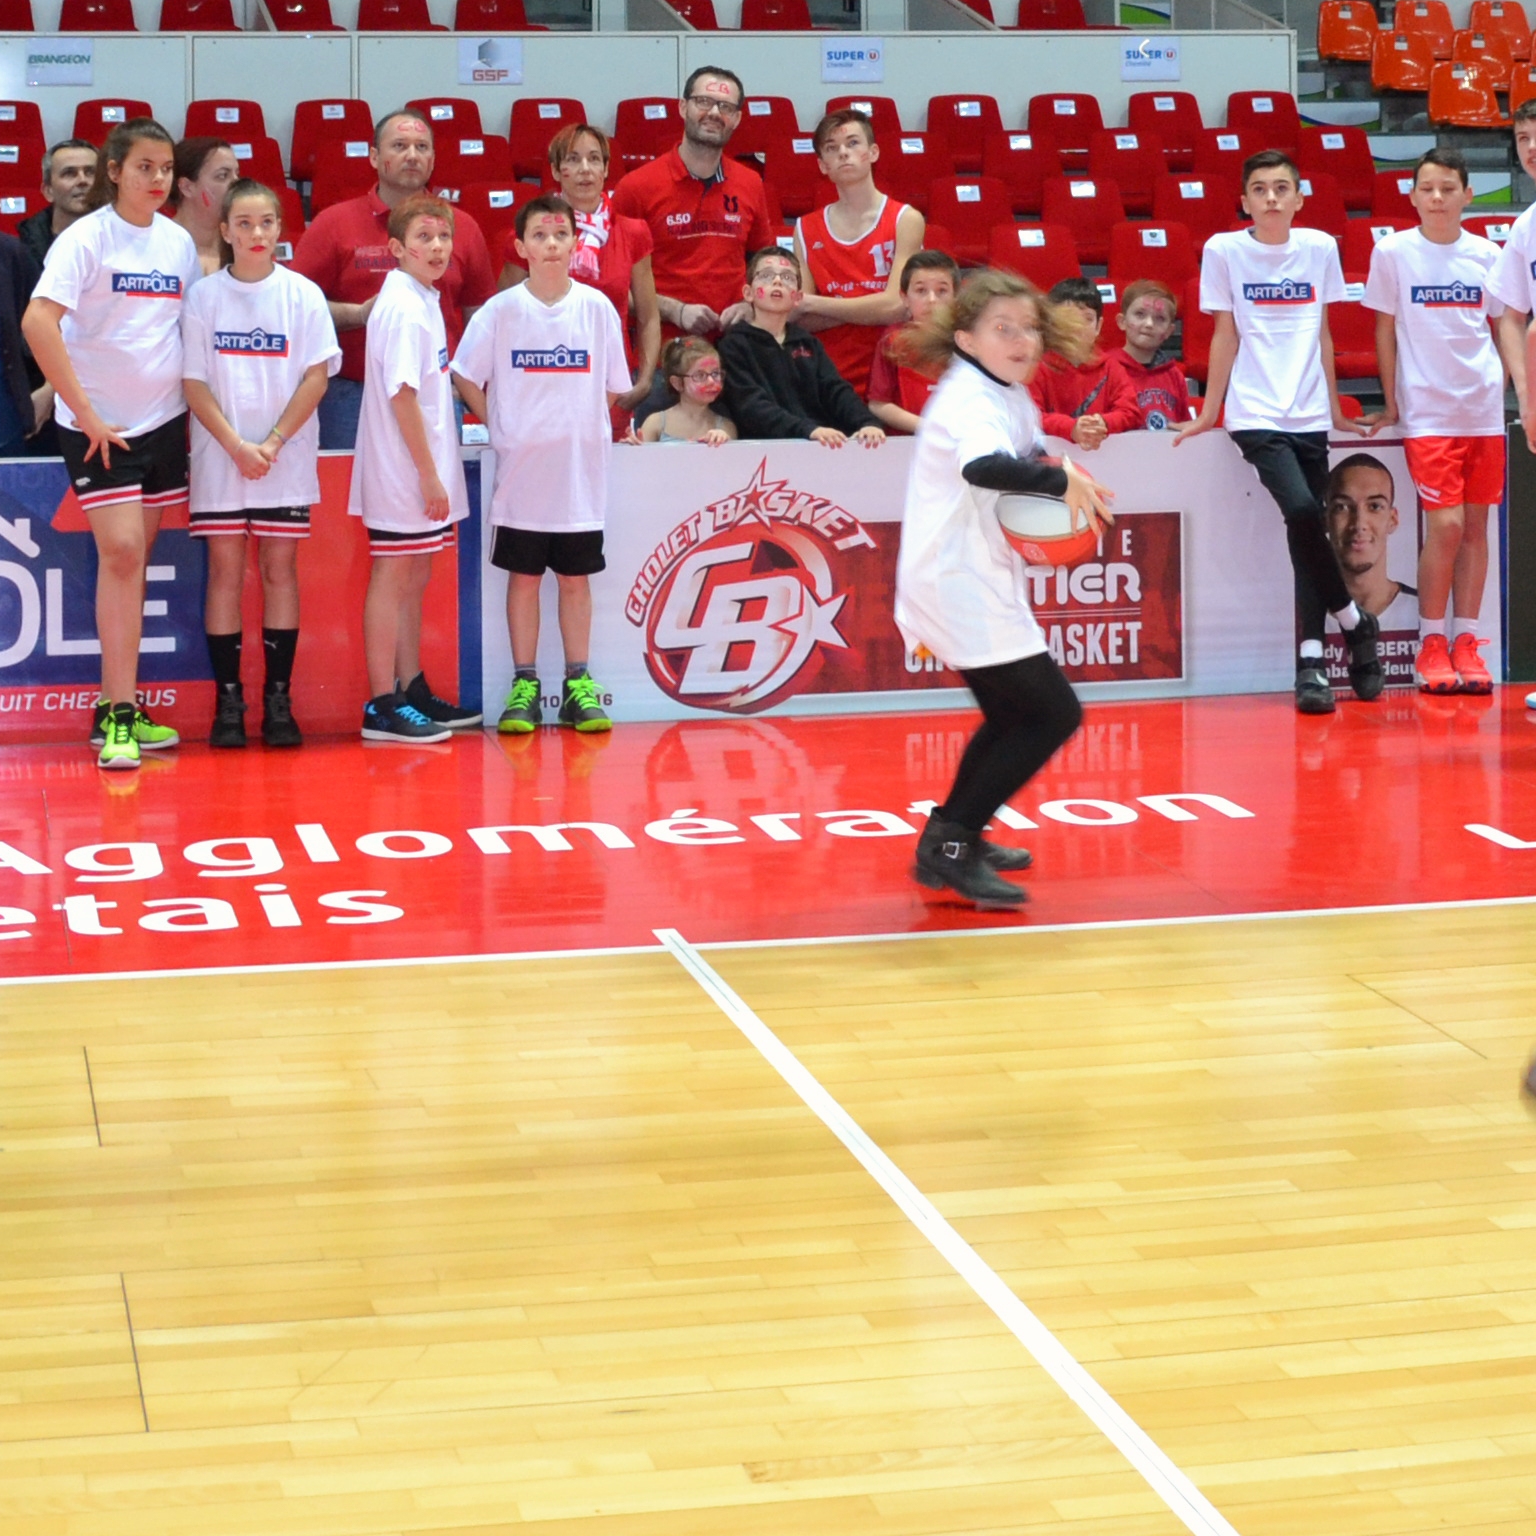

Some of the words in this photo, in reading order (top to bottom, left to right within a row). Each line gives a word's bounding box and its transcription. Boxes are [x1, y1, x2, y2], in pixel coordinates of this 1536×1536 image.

[28, 54, 92, 64] BRANGEON
[827, 51, 865, 61] SUPER
[473, 70, 510, 82] GSF
[117, 271, 178, 292] ARTIPÔLE
[1244, 280, 1308, 300] ARTIPÔLE
[1416, 282, 1480, 303] ARTIPÔLE
[214, 329, 283, 351] ARTIPÔLE
[515, 346, 585, 367] ARTIPÔLE
[625, 511, 702, 629] CHOLET
[1043, 621, 1143, 666] ASKET
[1323, 644, 1344, 663] dy
